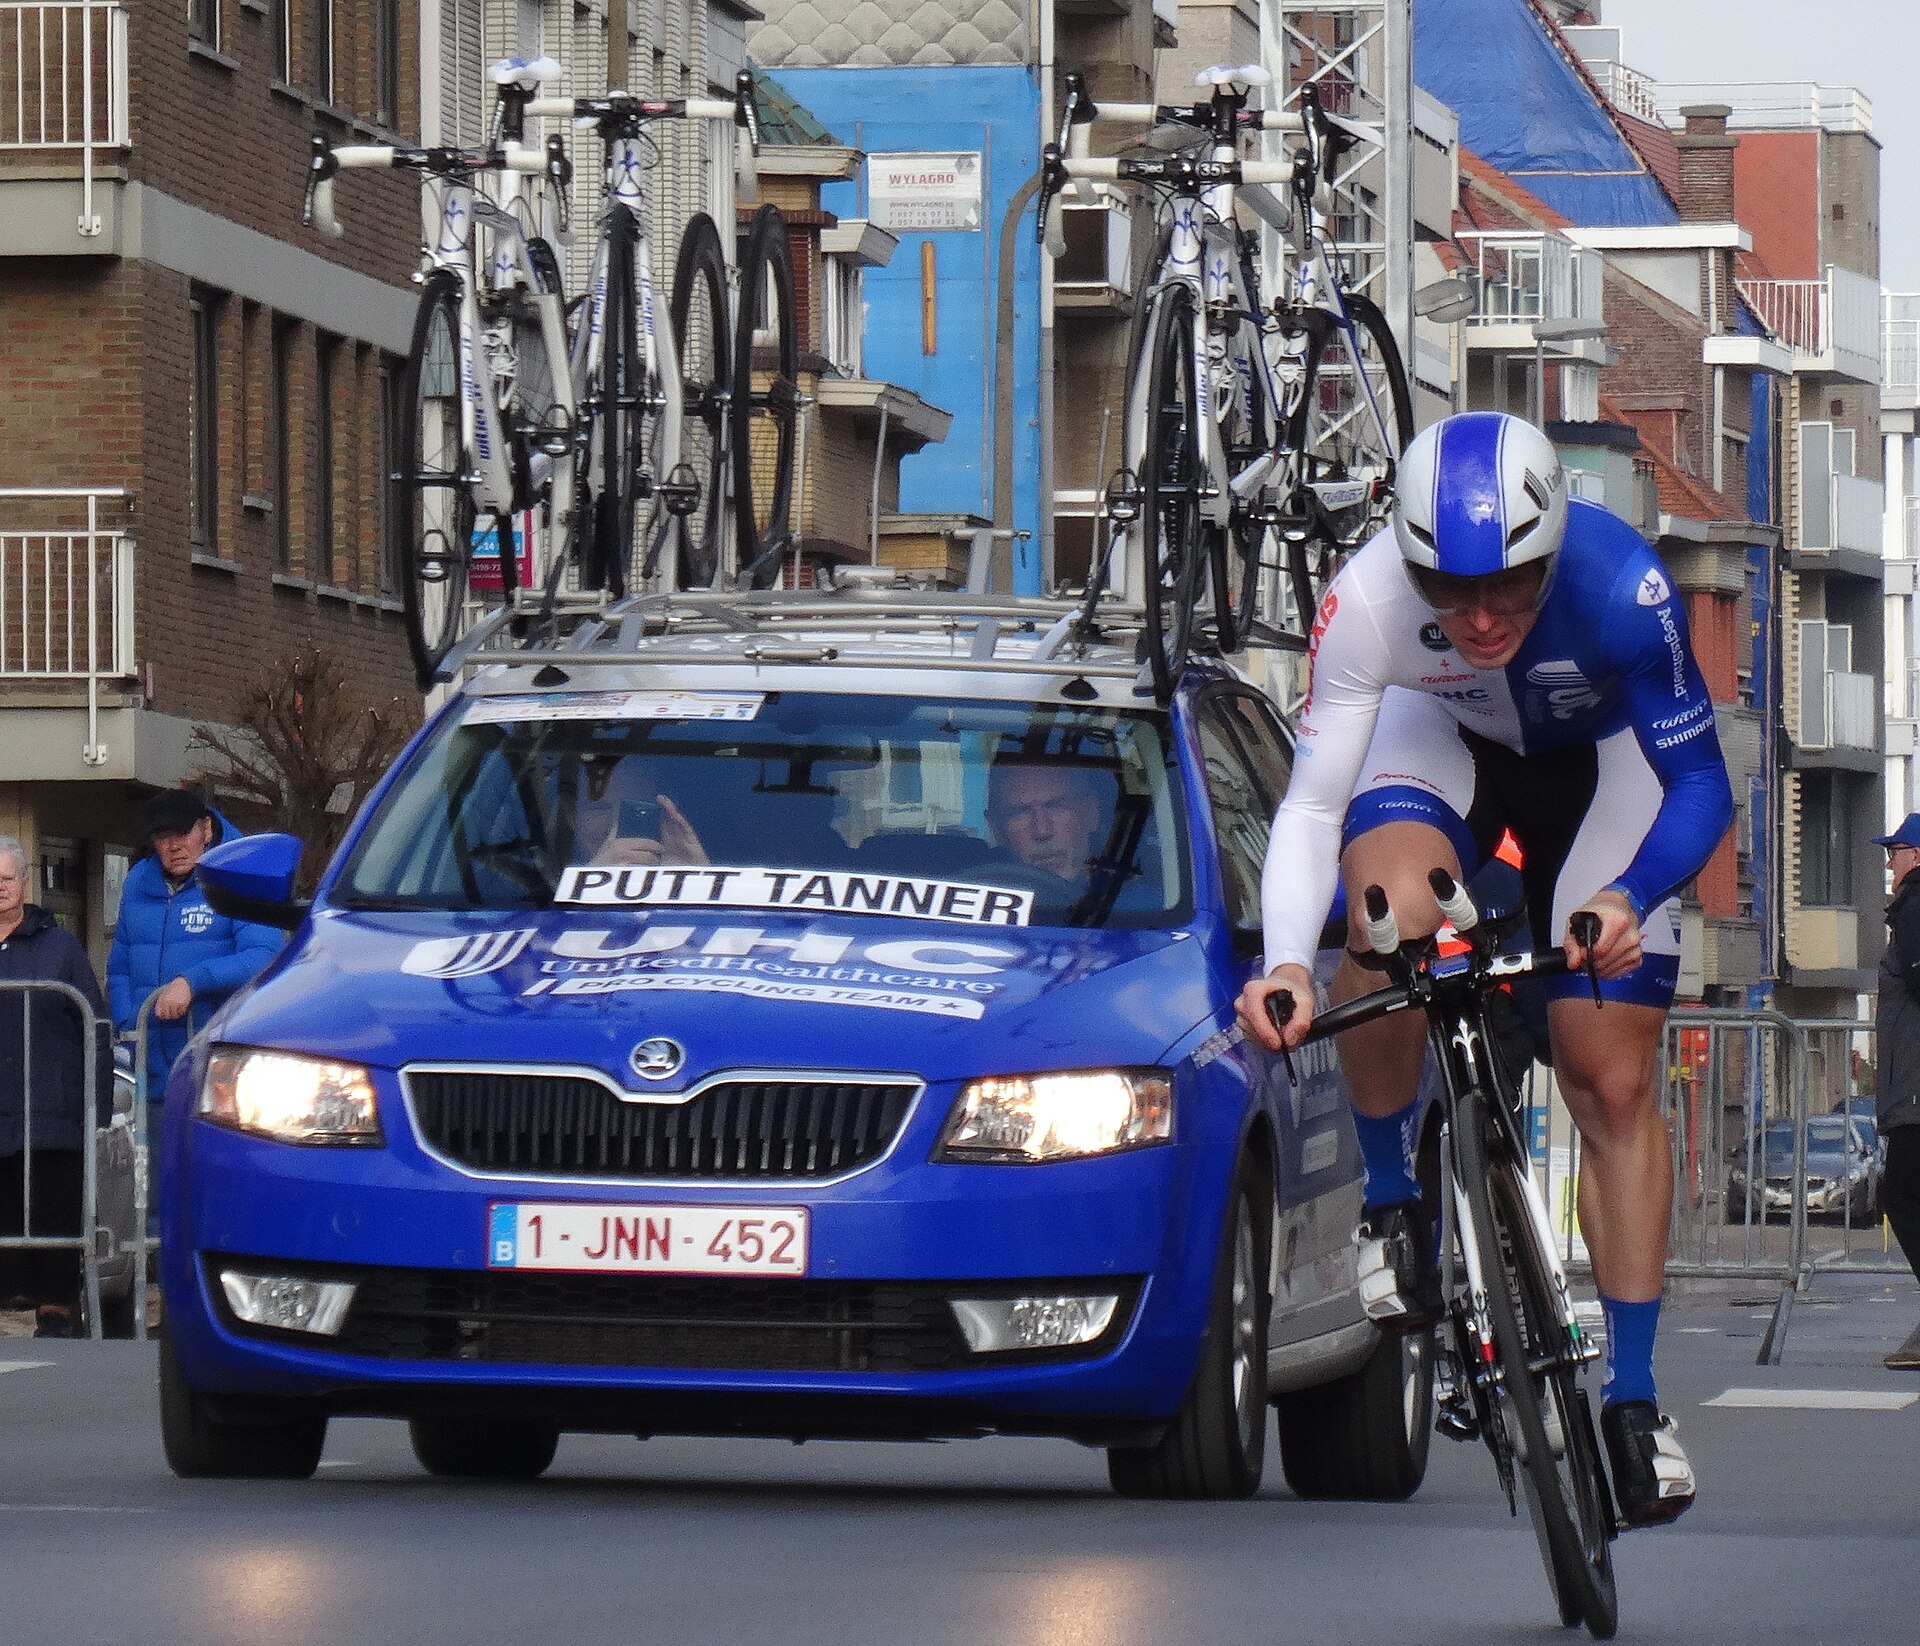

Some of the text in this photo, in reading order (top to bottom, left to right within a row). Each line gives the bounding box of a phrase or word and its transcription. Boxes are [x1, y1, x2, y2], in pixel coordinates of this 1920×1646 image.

[889, 174, 955, 184] WYLAGRO
[569, 870, 1024, 926] PUTT TANNER
[550, 926, 1014, 975] UHC
[540, 957, 1000, 994] UnitedHealthcare
[578, 977, 929, 1007] PRO CYCLING TEAM
[494, 1240, 515, 1262] B
